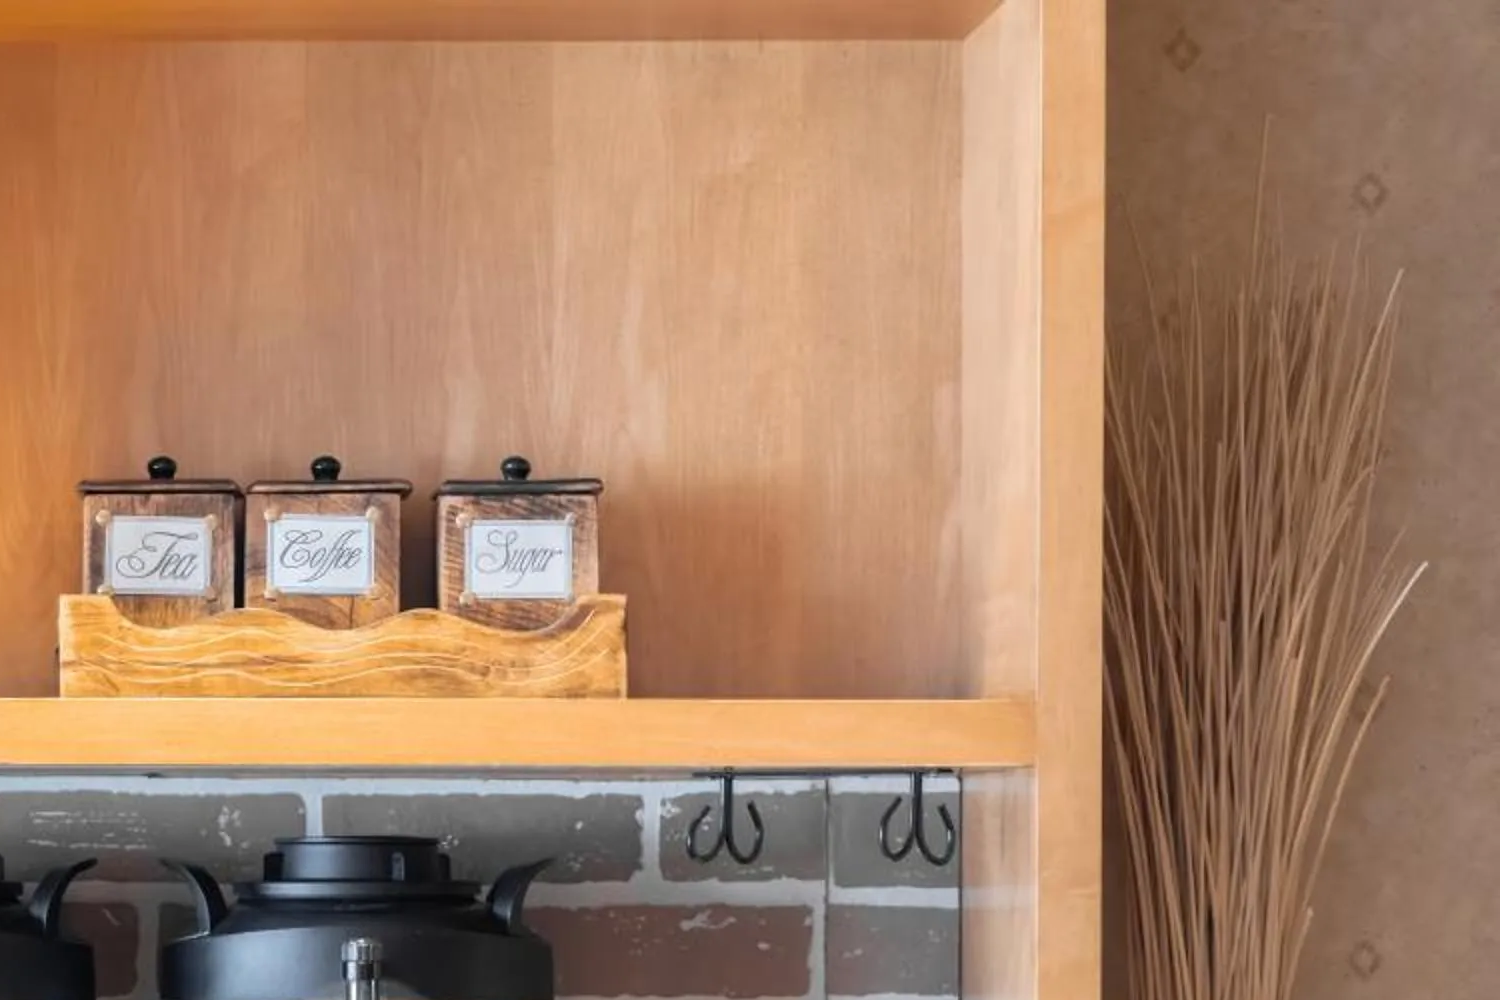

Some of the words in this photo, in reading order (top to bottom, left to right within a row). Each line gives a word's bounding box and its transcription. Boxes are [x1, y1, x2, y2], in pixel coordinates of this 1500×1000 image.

[115, 530, 199, 579] Tea
[280, 528, 362, 583] Coffee
[475, 529, 563, 589] Sugar
